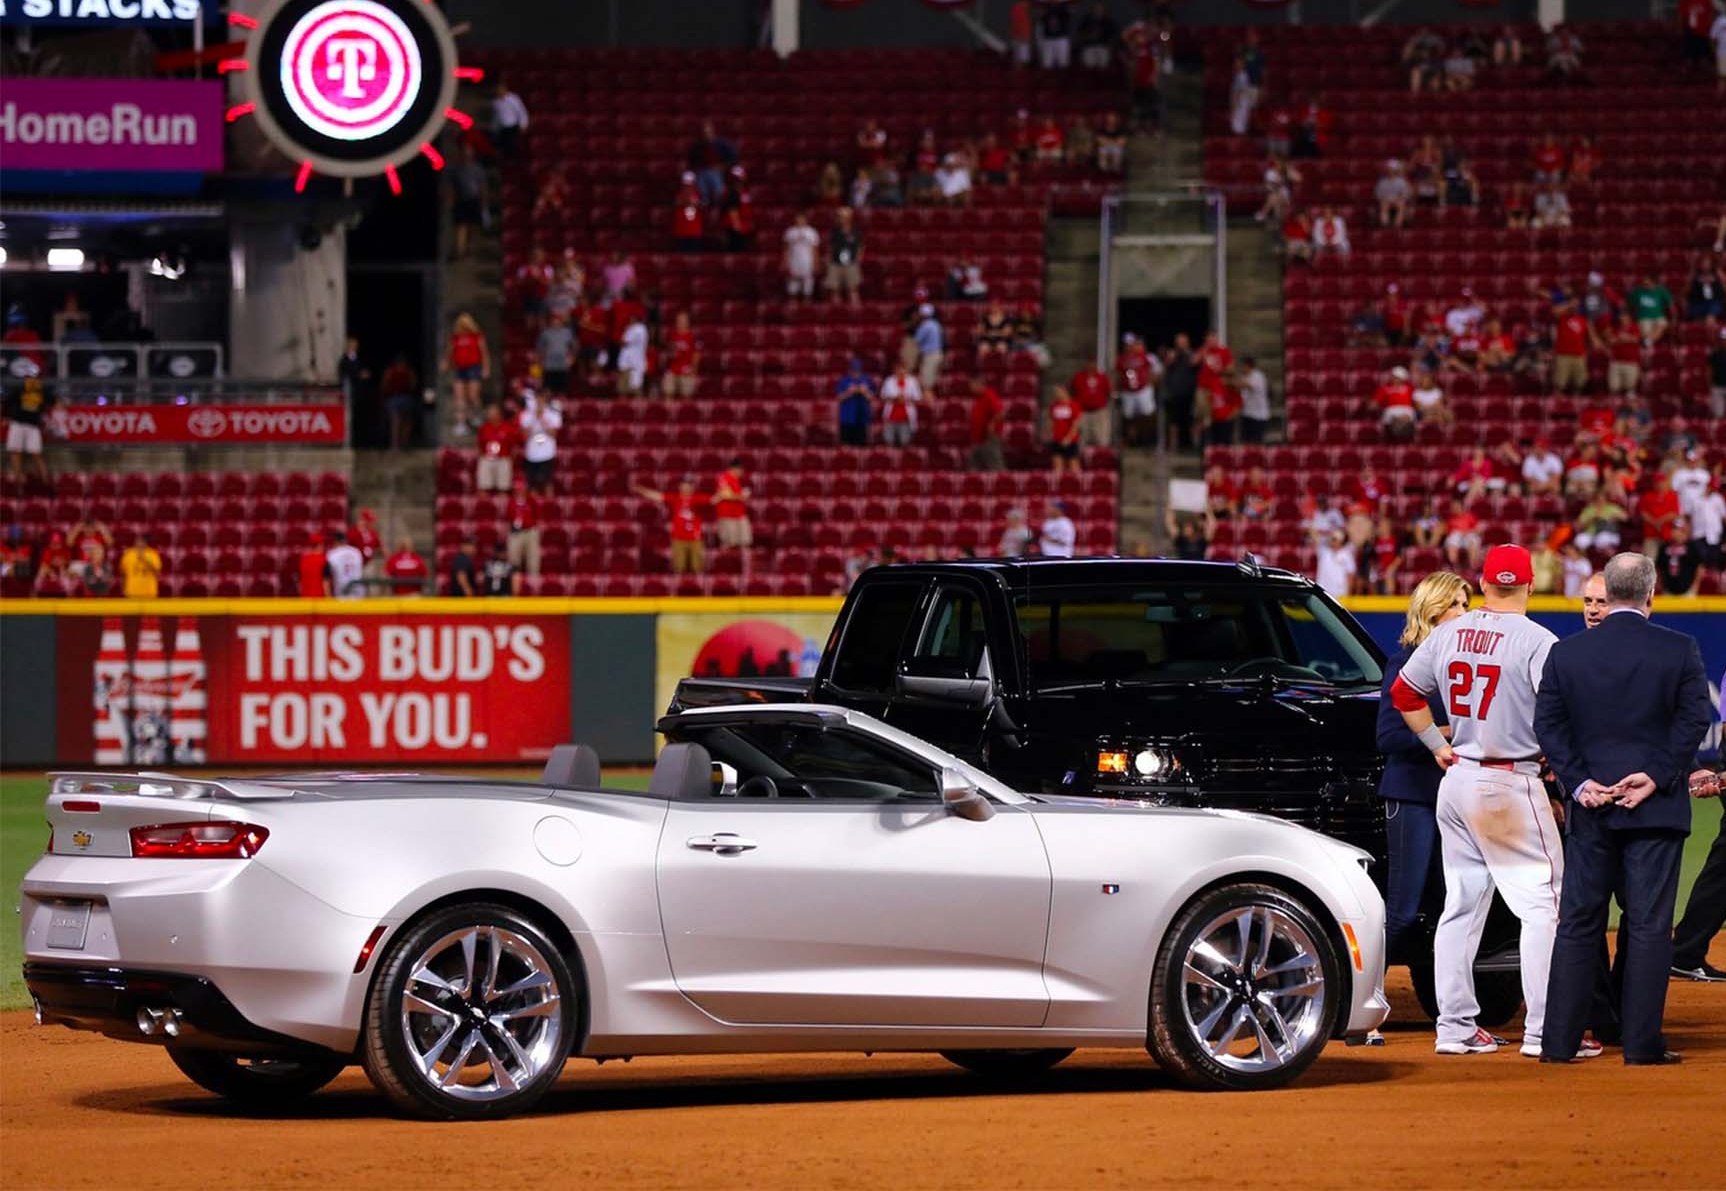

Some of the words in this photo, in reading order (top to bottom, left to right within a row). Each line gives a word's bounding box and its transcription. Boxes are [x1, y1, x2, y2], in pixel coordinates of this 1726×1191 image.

[229, 410, 332, 434] TOYOTA
[236, 625, 365, 681] THIS
[378, 625, 546, 682] BUD'S
[1456, 628, 1505, 656] TROUT
[1447, 660, 1502, 721] 27
[240, 692, 346, 749] FOR
[359, 692, 488, 749] YOU.
